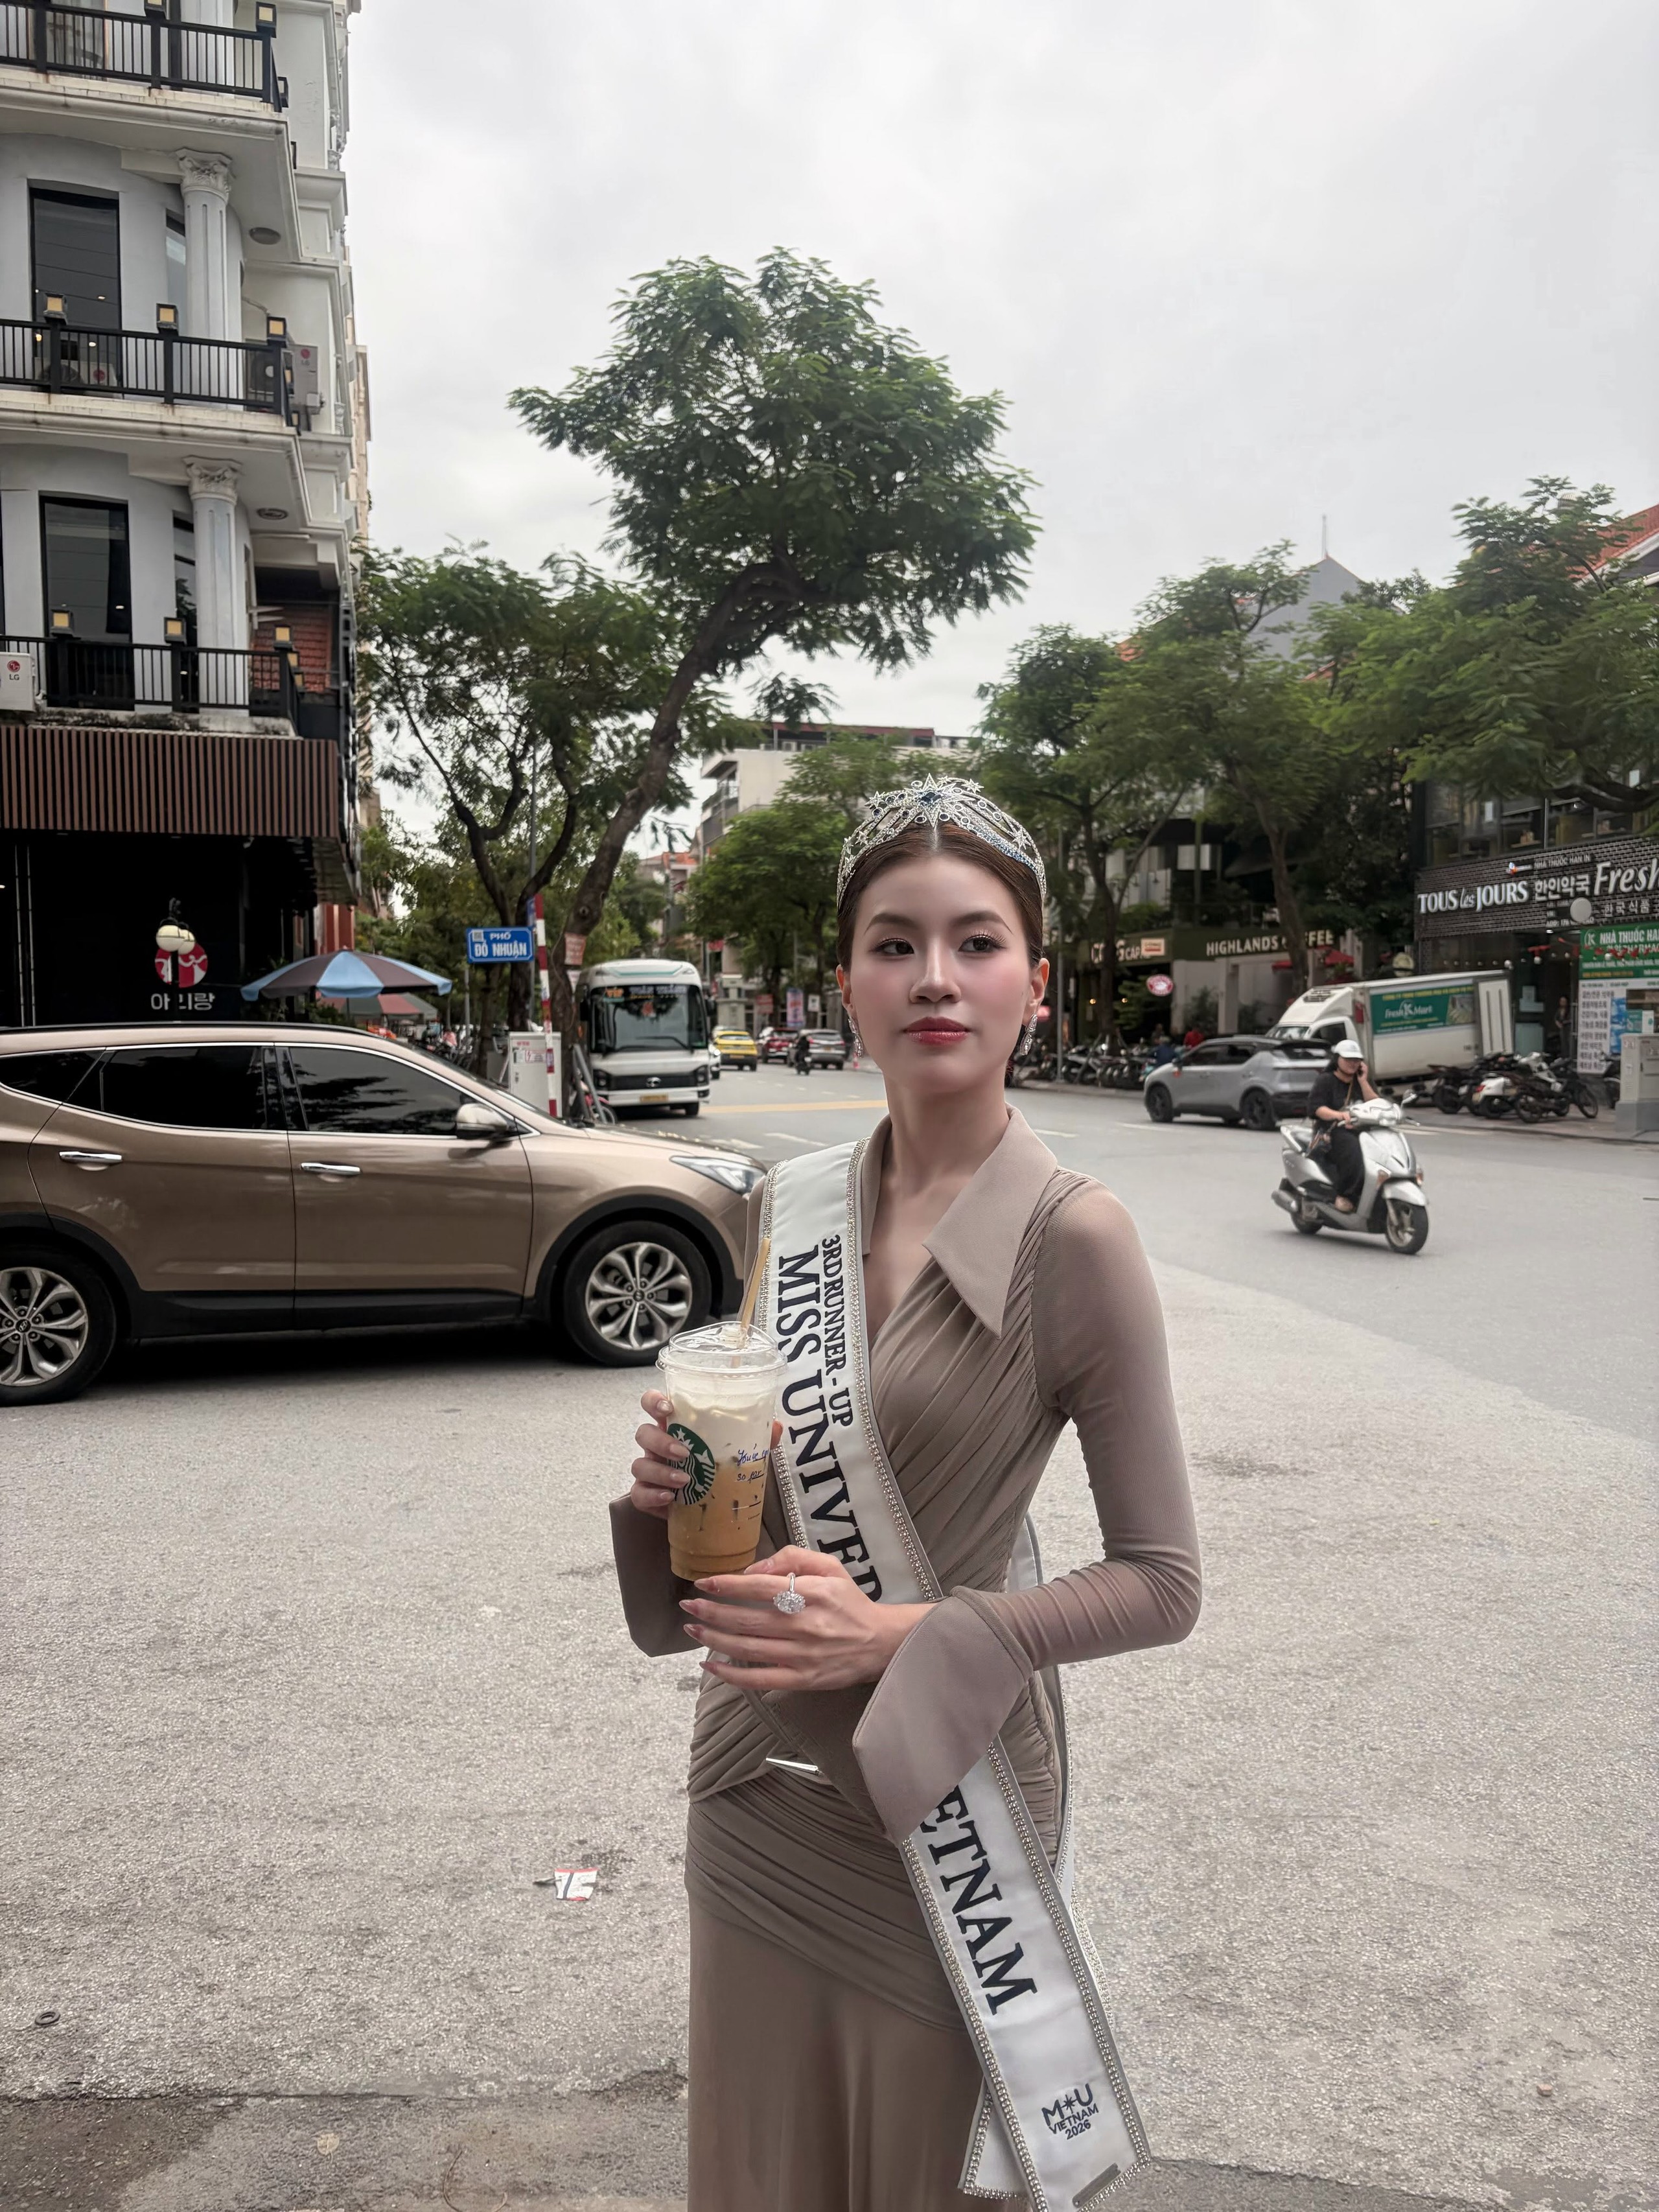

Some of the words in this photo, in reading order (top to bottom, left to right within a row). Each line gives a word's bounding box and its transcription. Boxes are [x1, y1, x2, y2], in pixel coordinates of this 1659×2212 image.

[1417, 890, 1458, 914] TOUS
[1460, 887, 1475, 909] les
[1476, 881, 1529, 913] JOURS
[1535, 874, 1591, 902] 한인약국
[493, 940, 527, 959] NHUẬN
[1206, 935, 1279, 957] HIGHLANDS
[821, 1234, 844, 1278] 3RD
[776, 1244, 822, 1364] MISS
[824, 1275, 847, 1376] RUNNER
[829, 1387, 854, 1427] UP
[1049, 2103, 1099, 2134] VIETNAM
[1065, 2119, 1091, 2140] 2026
